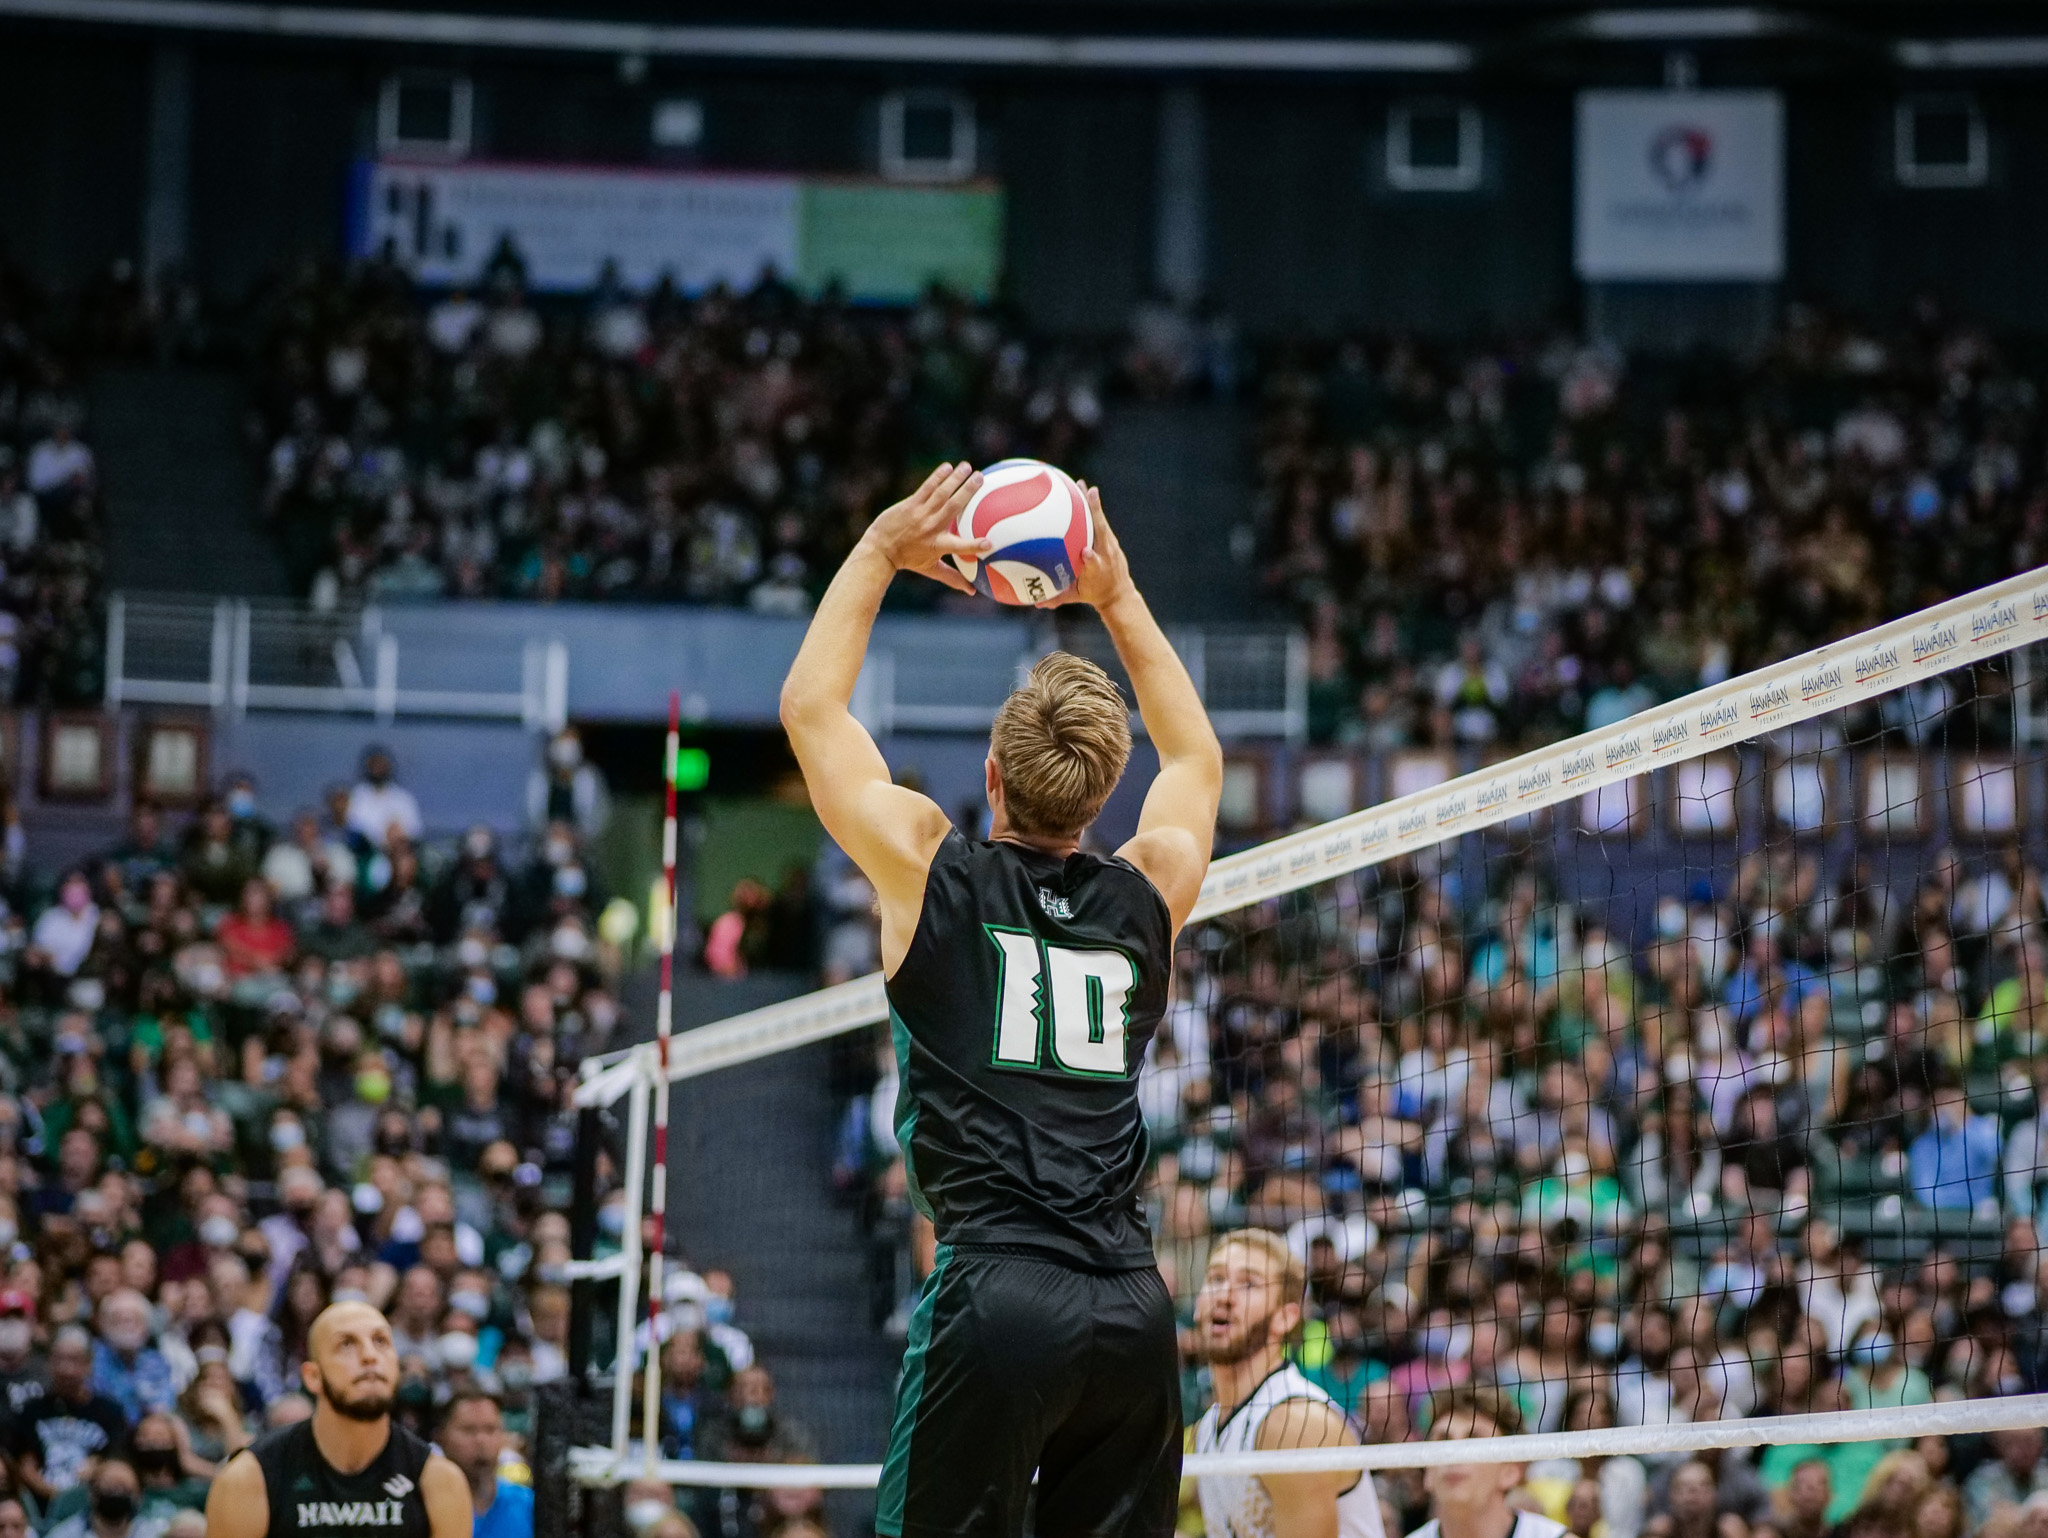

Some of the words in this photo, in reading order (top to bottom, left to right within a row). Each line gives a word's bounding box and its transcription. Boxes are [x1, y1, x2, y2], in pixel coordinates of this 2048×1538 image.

[1971, 603, 2017, 644] HAWAIIAN
[1982, 634, 2010, 648] ISLANDS
[1912, 625, 1957, 664] HAWAIIAN
[1924, 655, 1950, 669] ISLANDS
[1855, 646, 1898, 685] HAWAIIAN
[1867, 675, 1892, 689] ISLANDS
[1749, 684, 1788, 720] HAWAIIAN
[1801, 666, 1842, 703] HAWAIIAN
[1652, 720, 1688, 755] HAWAIIAN
[1700, 702, 1738, 738] HAWAIIAN
[982, 923, 1138, 1079] 10
